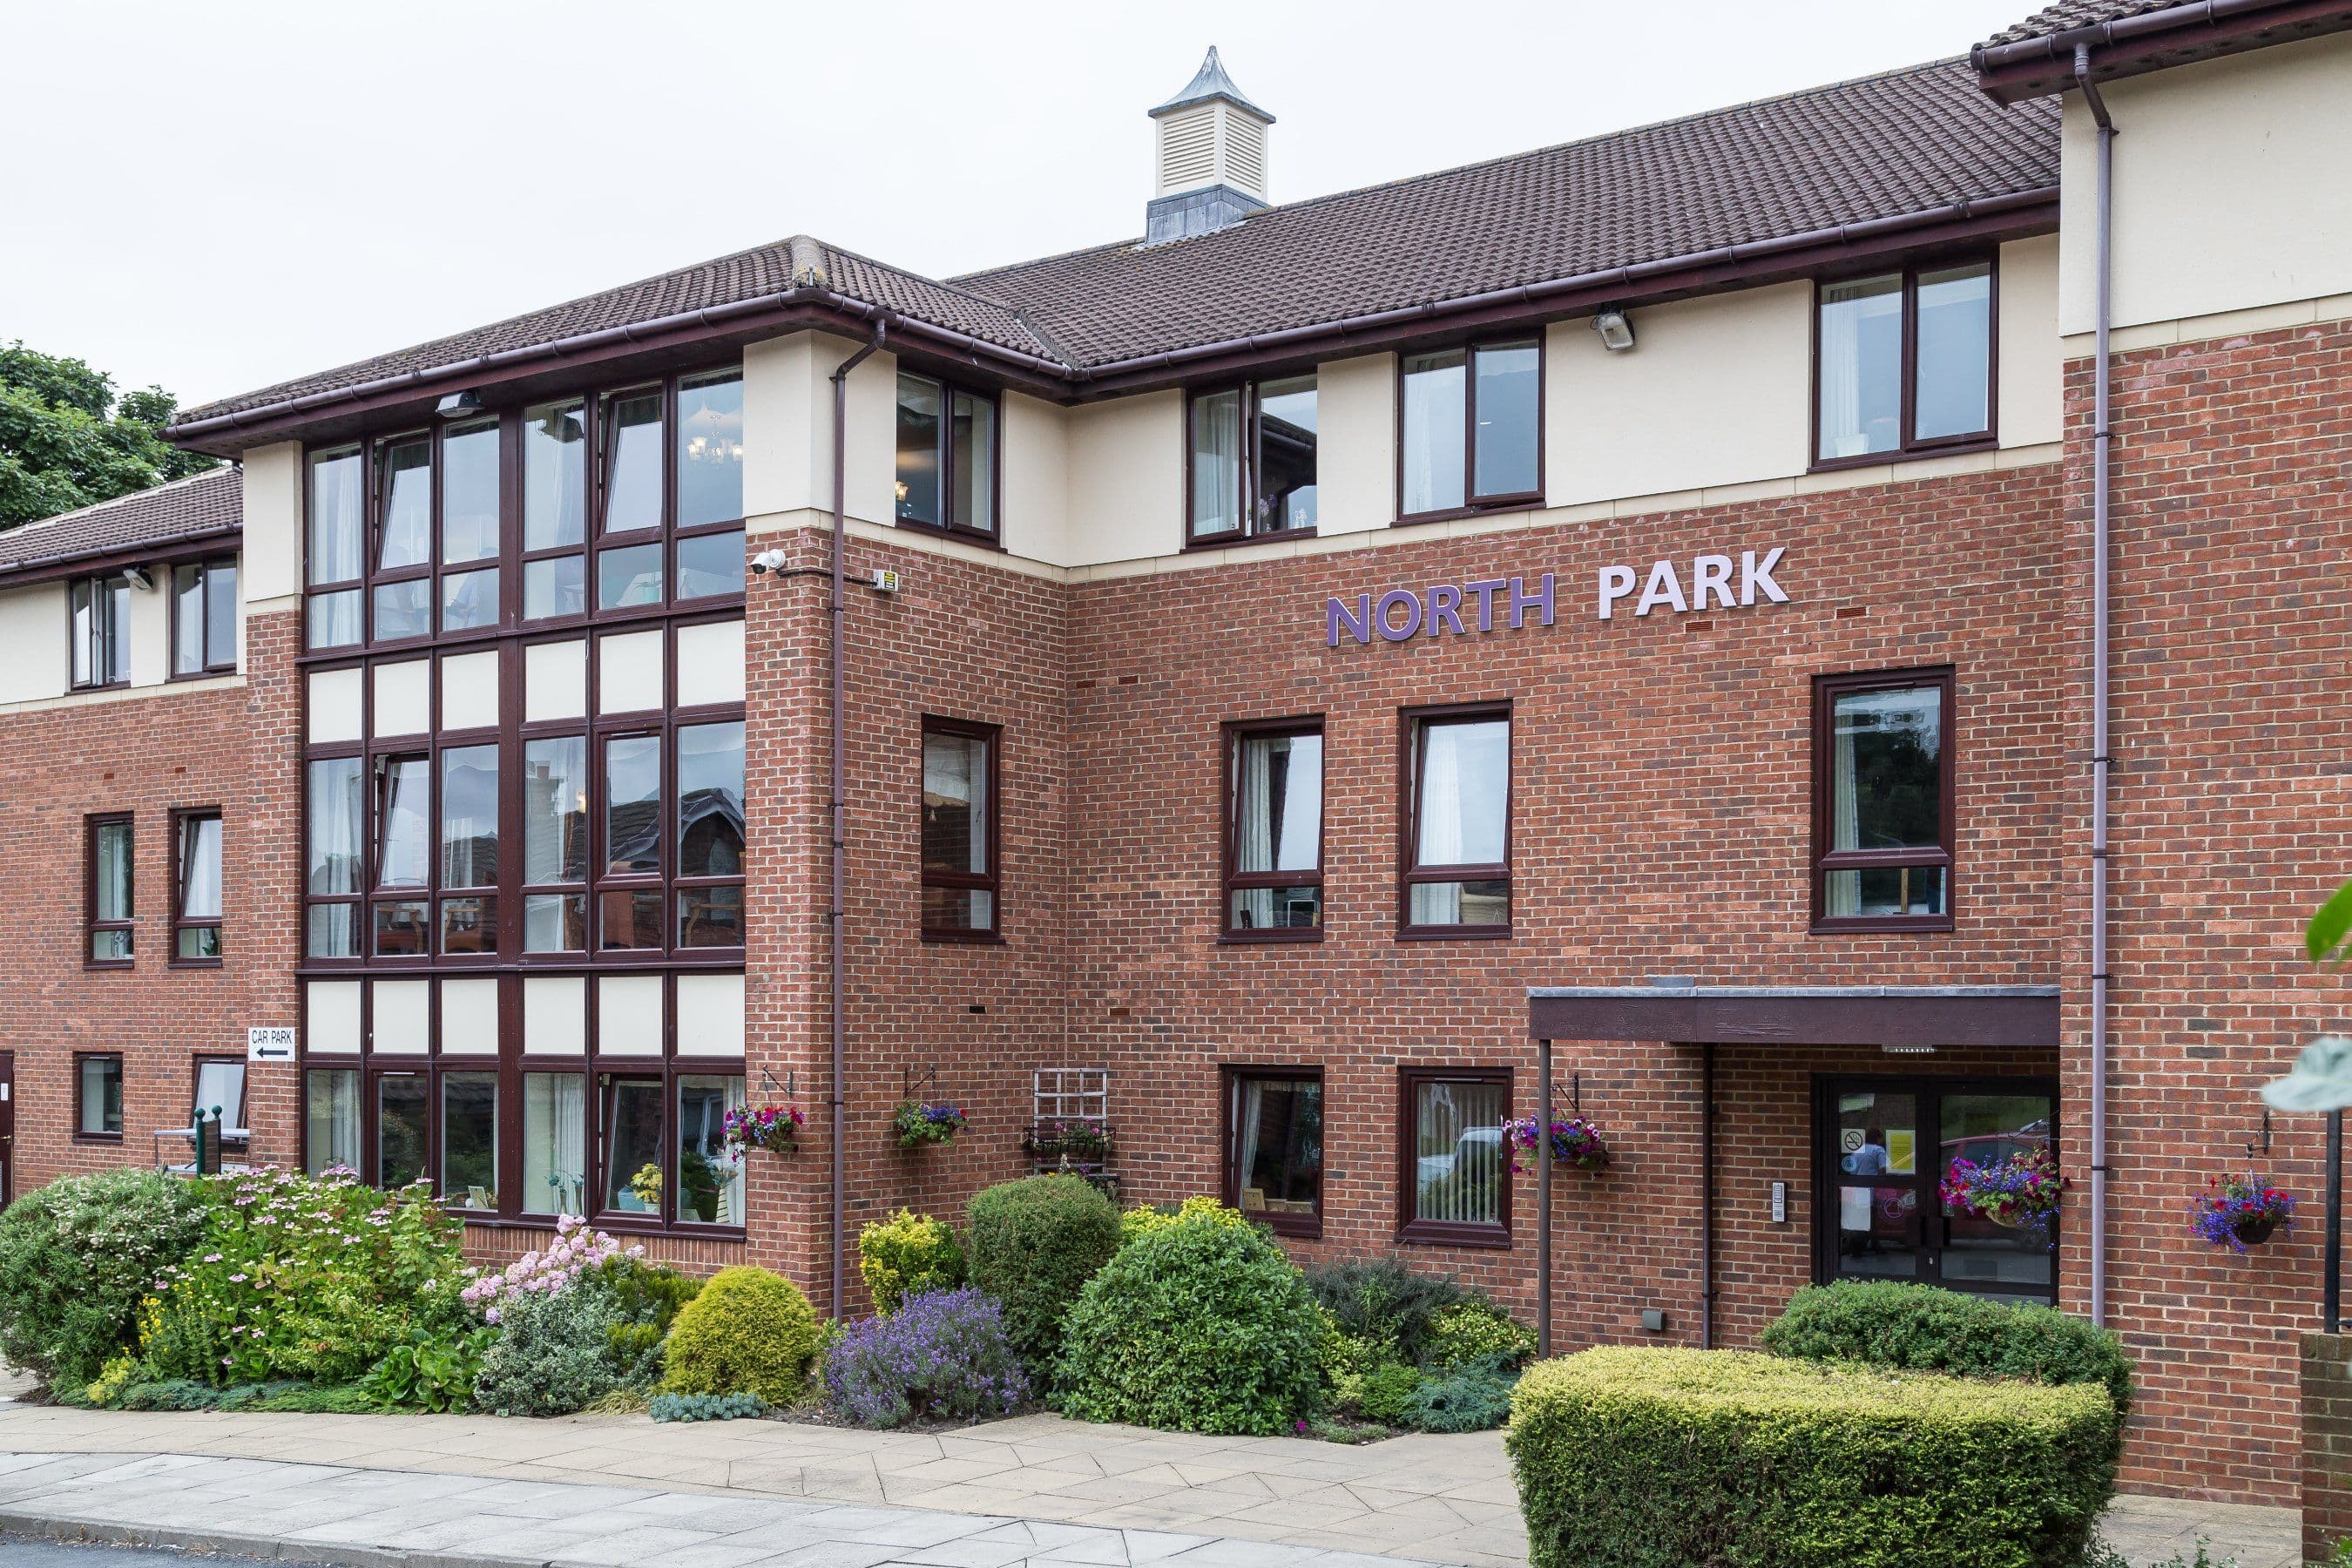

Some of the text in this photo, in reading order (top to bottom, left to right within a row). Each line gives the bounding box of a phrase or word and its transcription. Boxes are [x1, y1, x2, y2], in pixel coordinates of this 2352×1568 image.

[1327, 546, 1791, 646] NORTH PARK
[252, 1030, 292, 1044] CAR PARK
